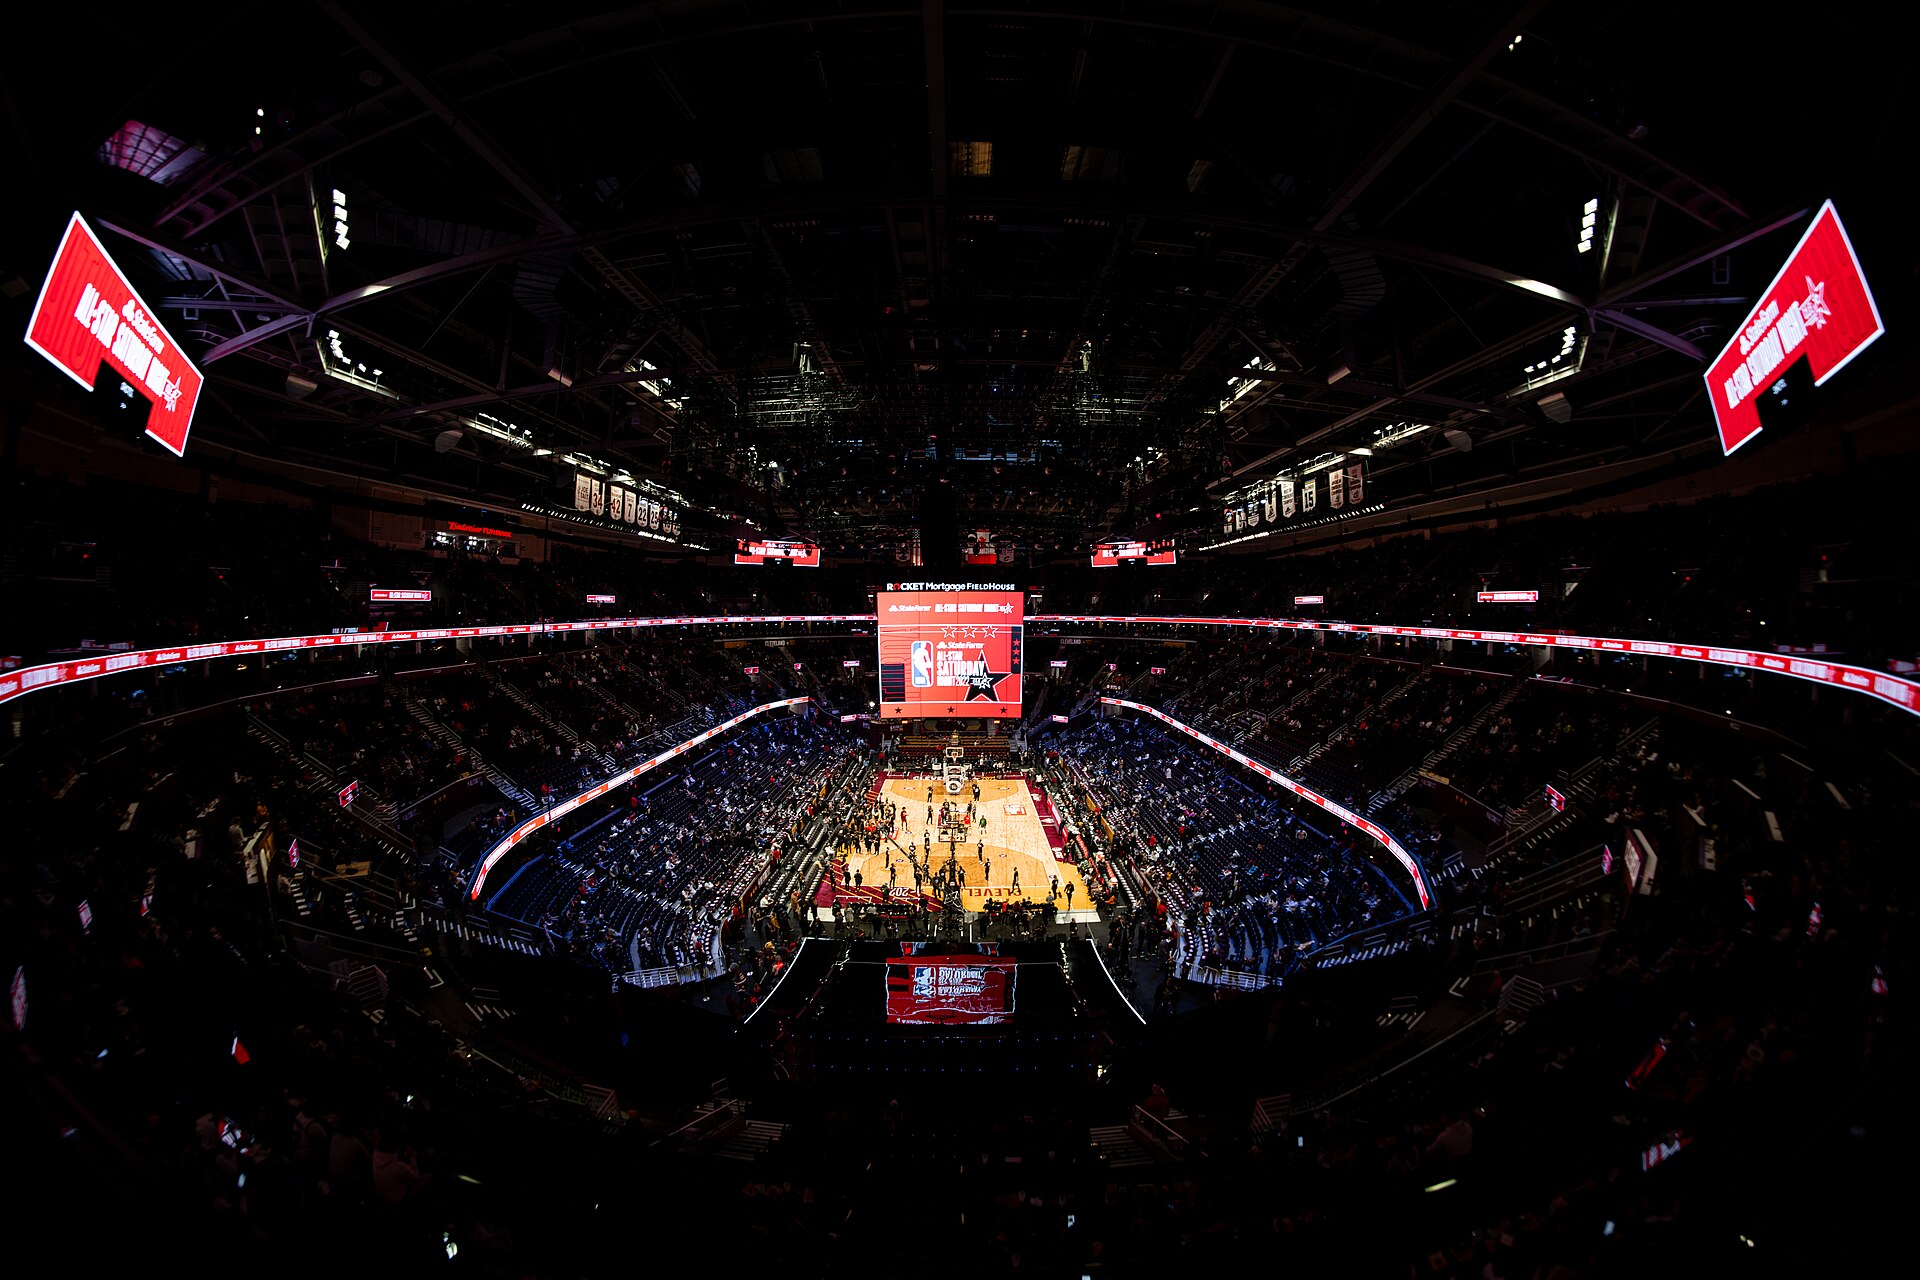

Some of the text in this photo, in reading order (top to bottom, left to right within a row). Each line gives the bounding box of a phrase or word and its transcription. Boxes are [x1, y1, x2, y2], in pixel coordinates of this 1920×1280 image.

[592, 492, 603, 509] 34
[611, 498, 621, 515] 42
[1304, 491, 1314, 512] 15
[627, 503, 633, 518] 7
[638, 506, 647, 523] 22
[650, 509, 659, 525] 25
[886, 582, 925, 591] ROCKET
[925, 582, 966, 592] Mortgage
[957, 603, 984, 613] SATURDAY
[936, 650, 963, 661] ALL-STAR
[936, 660, 985, 676] SATURDAY
[965, 887, 1022, 897] CLEVEL
